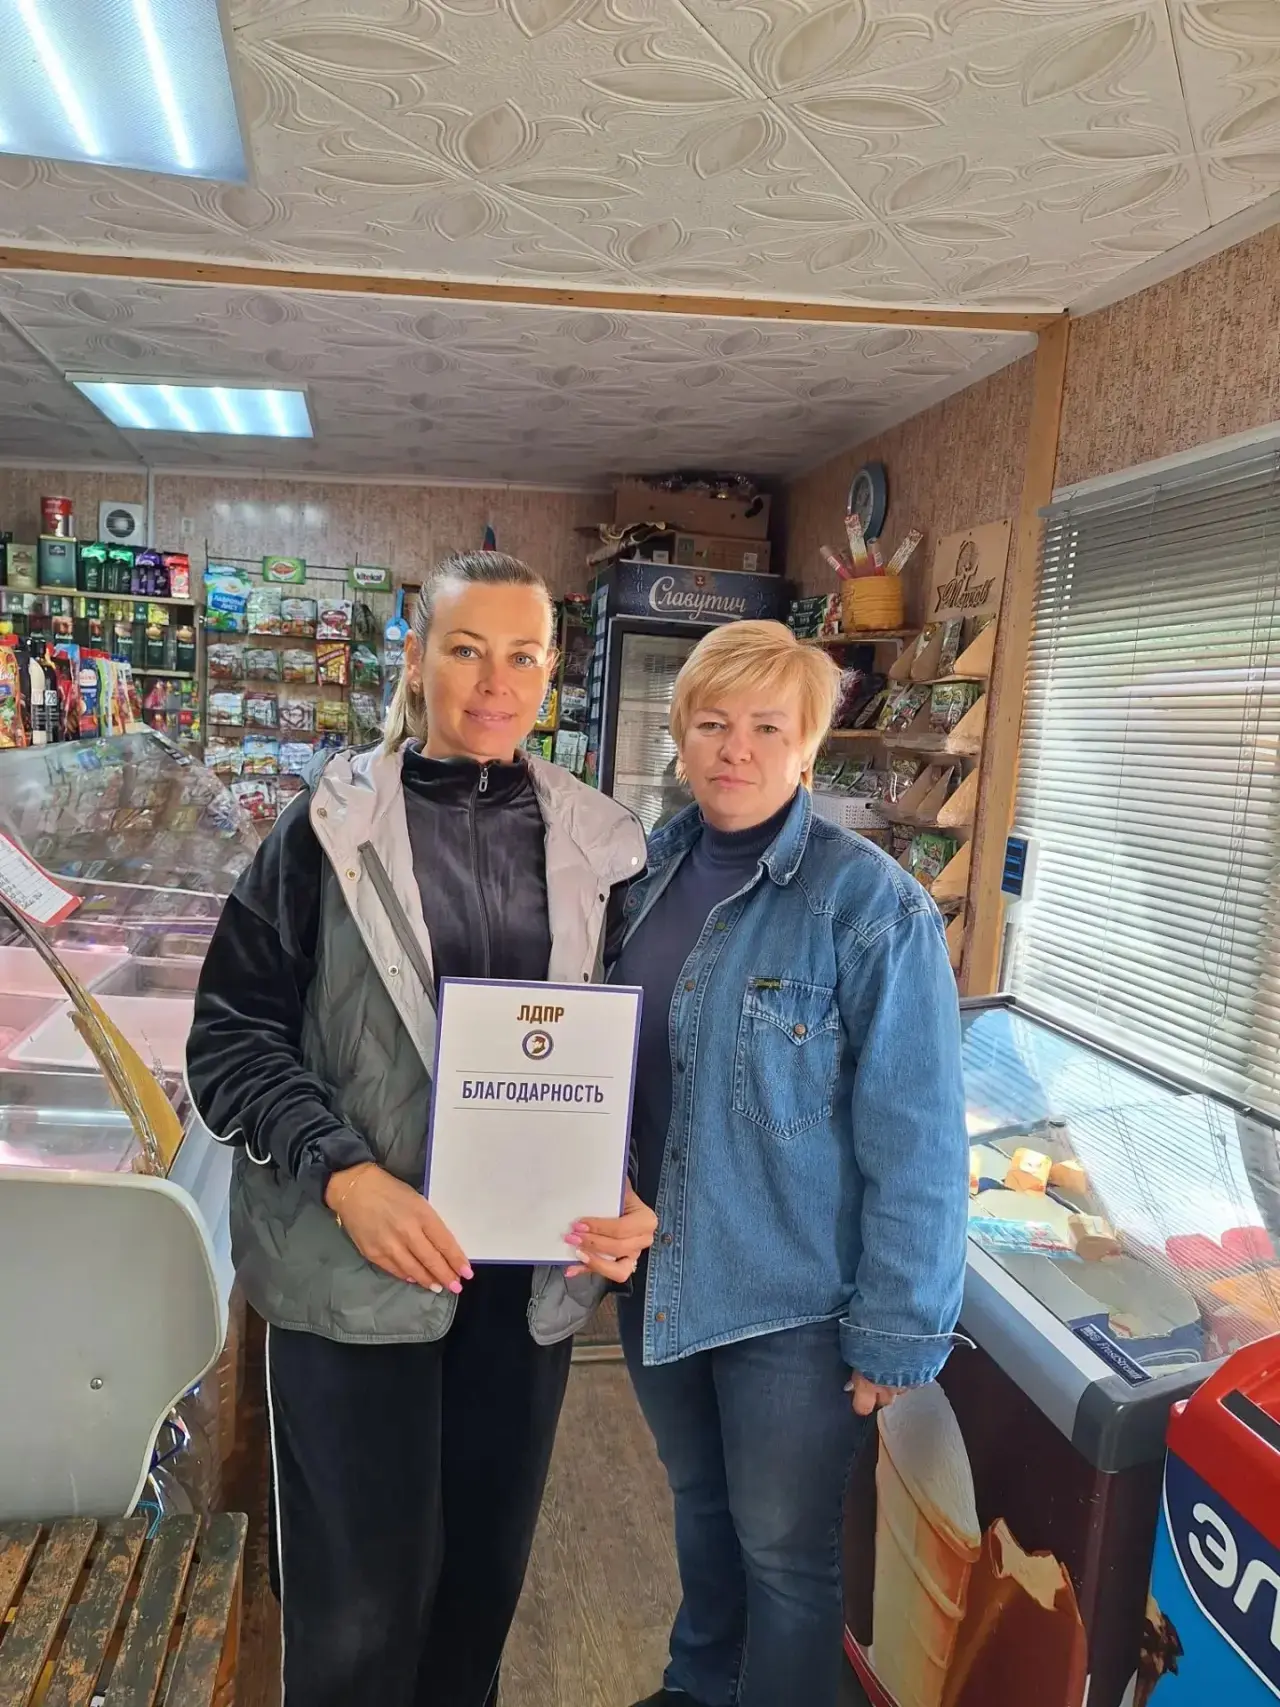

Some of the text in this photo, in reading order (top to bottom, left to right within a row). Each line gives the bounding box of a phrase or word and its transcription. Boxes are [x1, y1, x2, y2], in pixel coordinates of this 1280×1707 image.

[649, 576, 746, 620] Славутич
[517, 1004, 565, 1024] ЛДПР
[462, 1080, 604, 1103] БЛАГОДАРНОСТЬ
